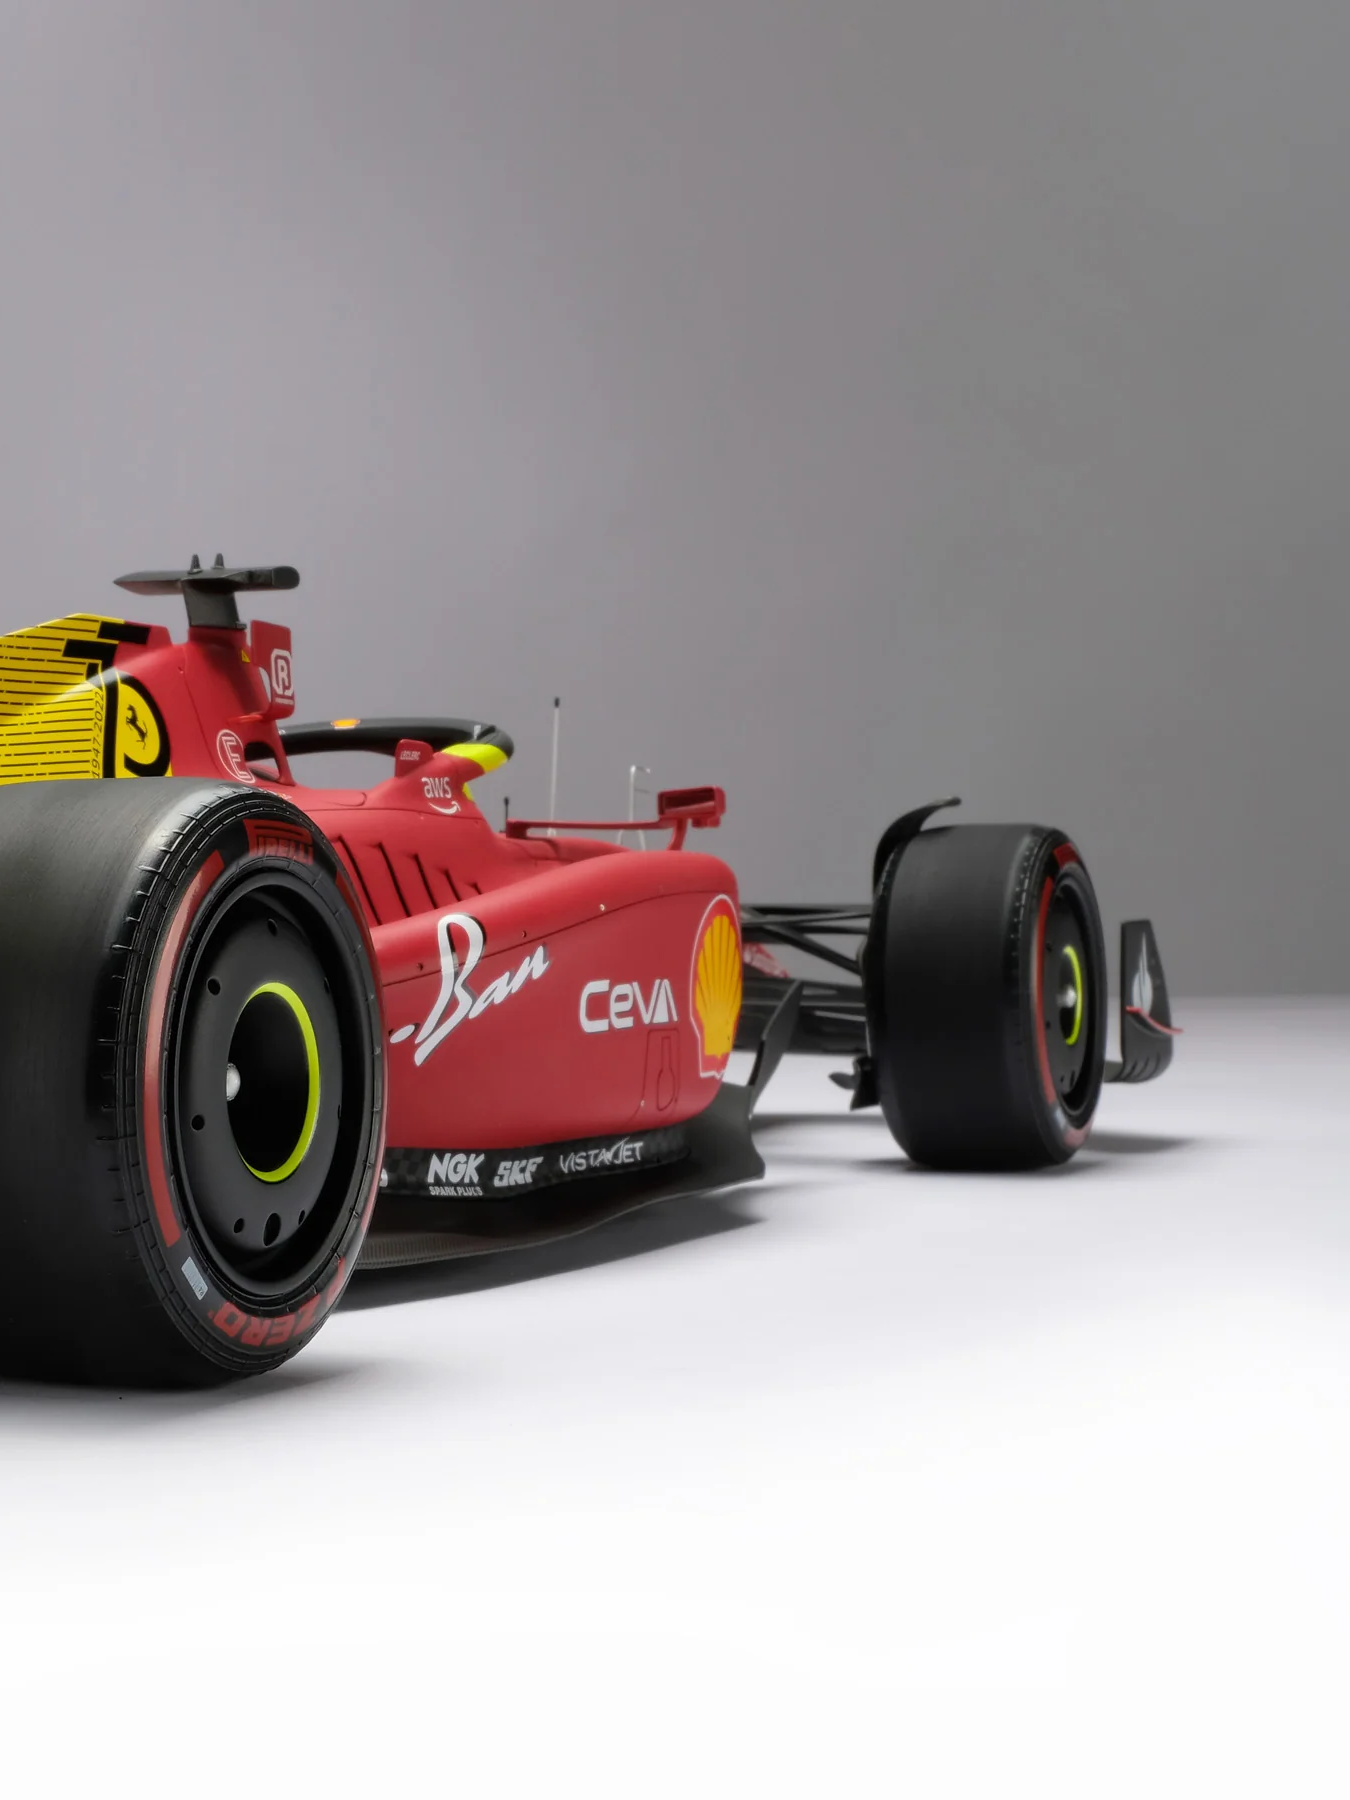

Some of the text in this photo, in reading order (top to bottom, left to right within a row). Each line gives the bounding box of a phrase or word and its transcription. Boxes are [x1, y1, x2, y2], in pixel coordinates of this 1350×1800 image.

[421, 776, 452, 799] aws
[243, 818, 314, 865] PIRELLI
[427, 1152, 485, 1184] NGK
[493, 1156, 544, 1188] SKF
[429, 1186, 457, 1196] SPARK
